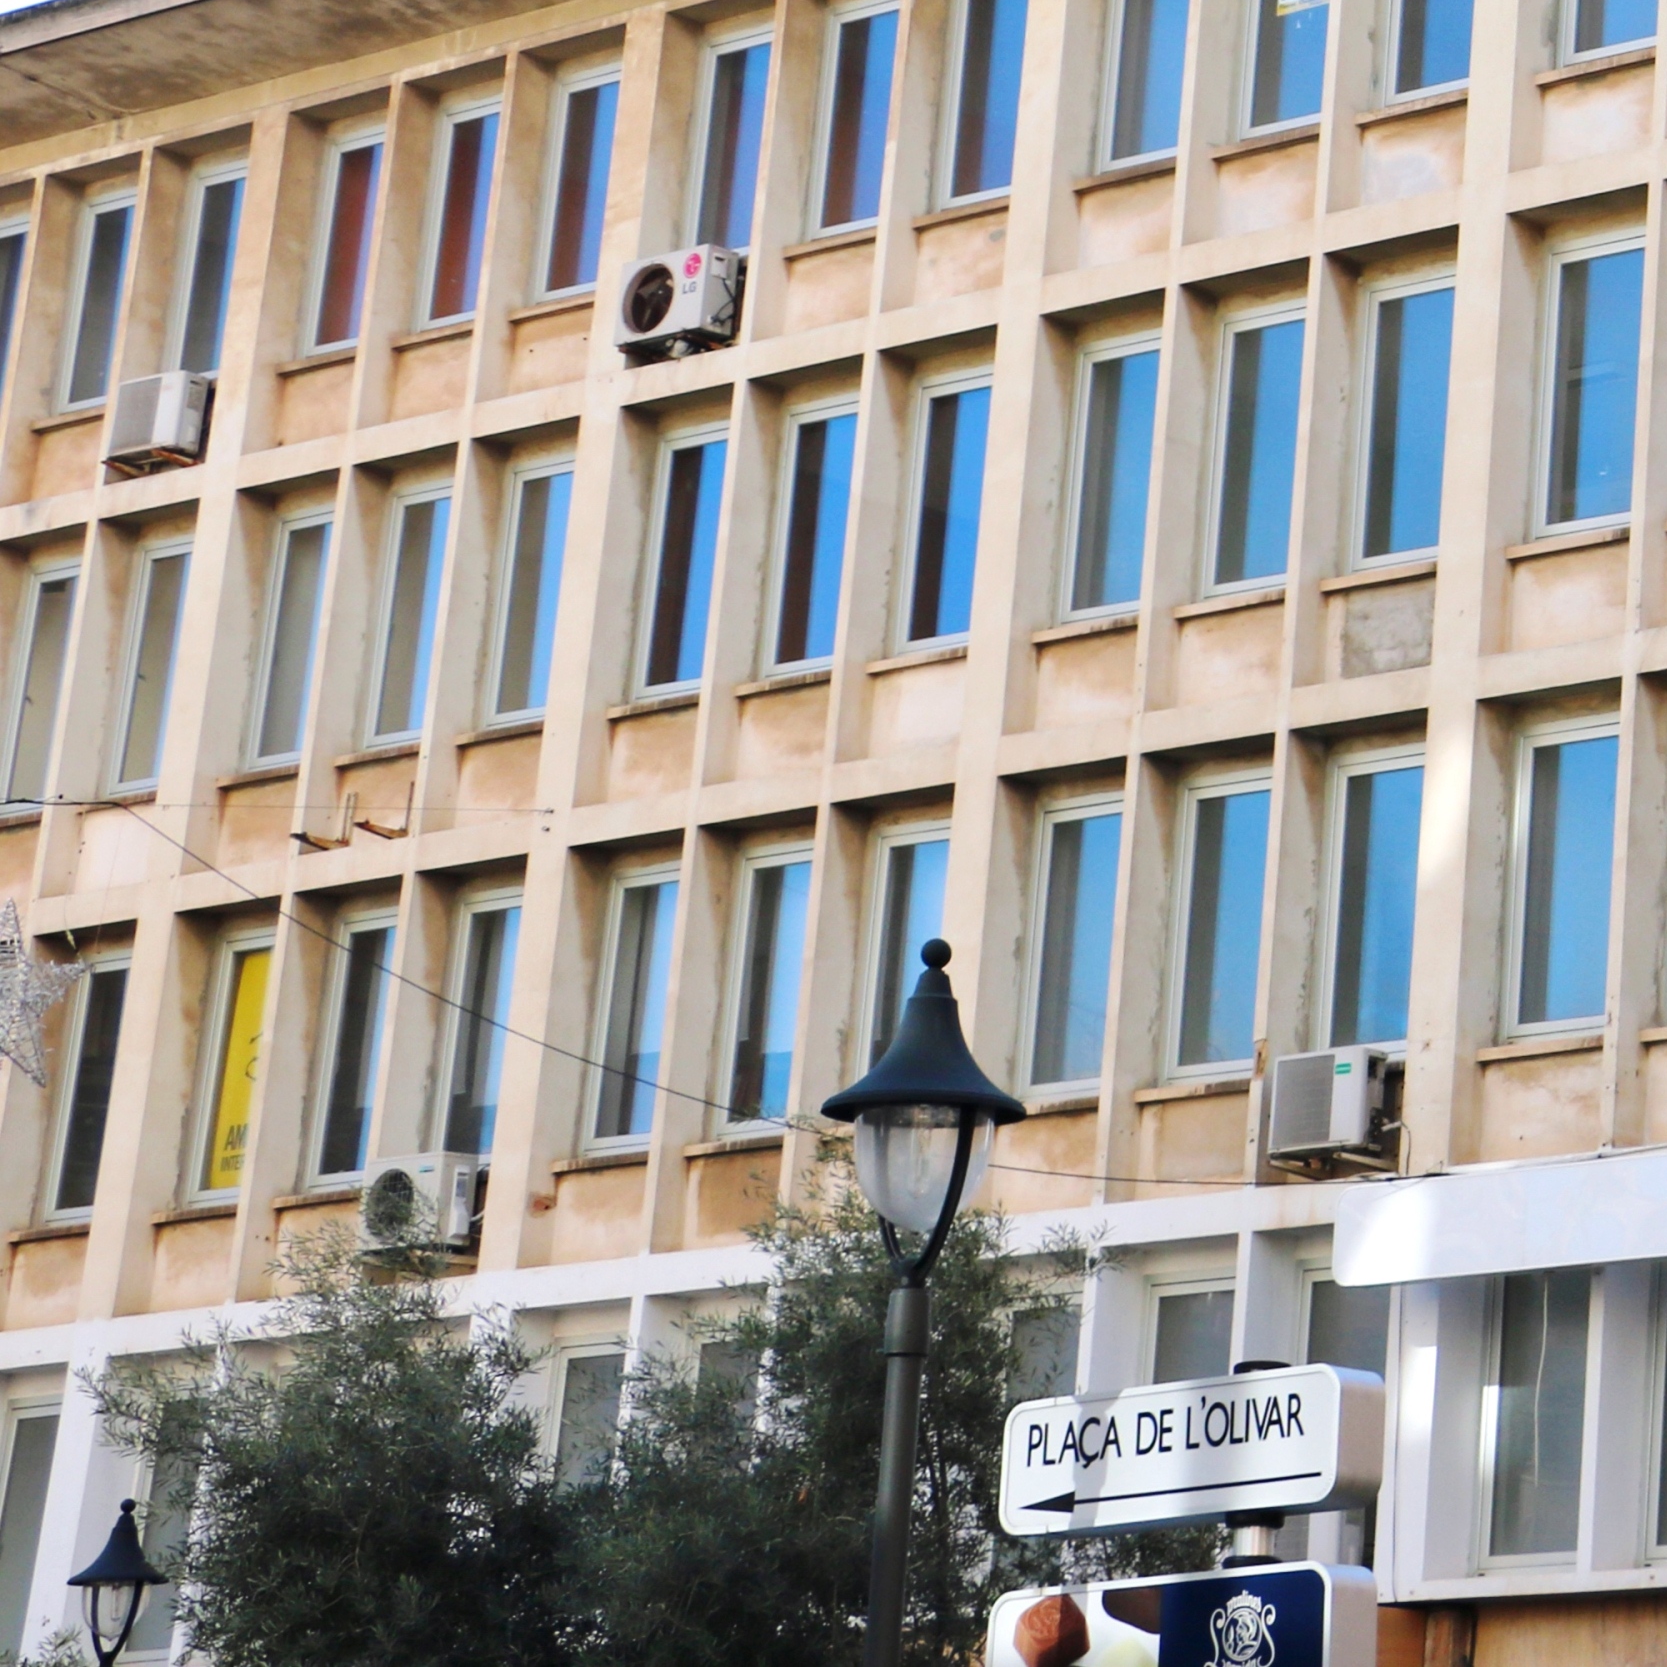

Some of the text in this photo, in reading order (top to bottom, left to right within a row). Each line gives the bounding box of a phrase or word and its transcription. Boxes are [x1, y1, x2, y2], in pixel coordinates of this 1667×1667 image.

[682, 281, 697, 294] LG
[1027, 1393, 1304, 1468] PLAÇA DE L'OLIVAR
